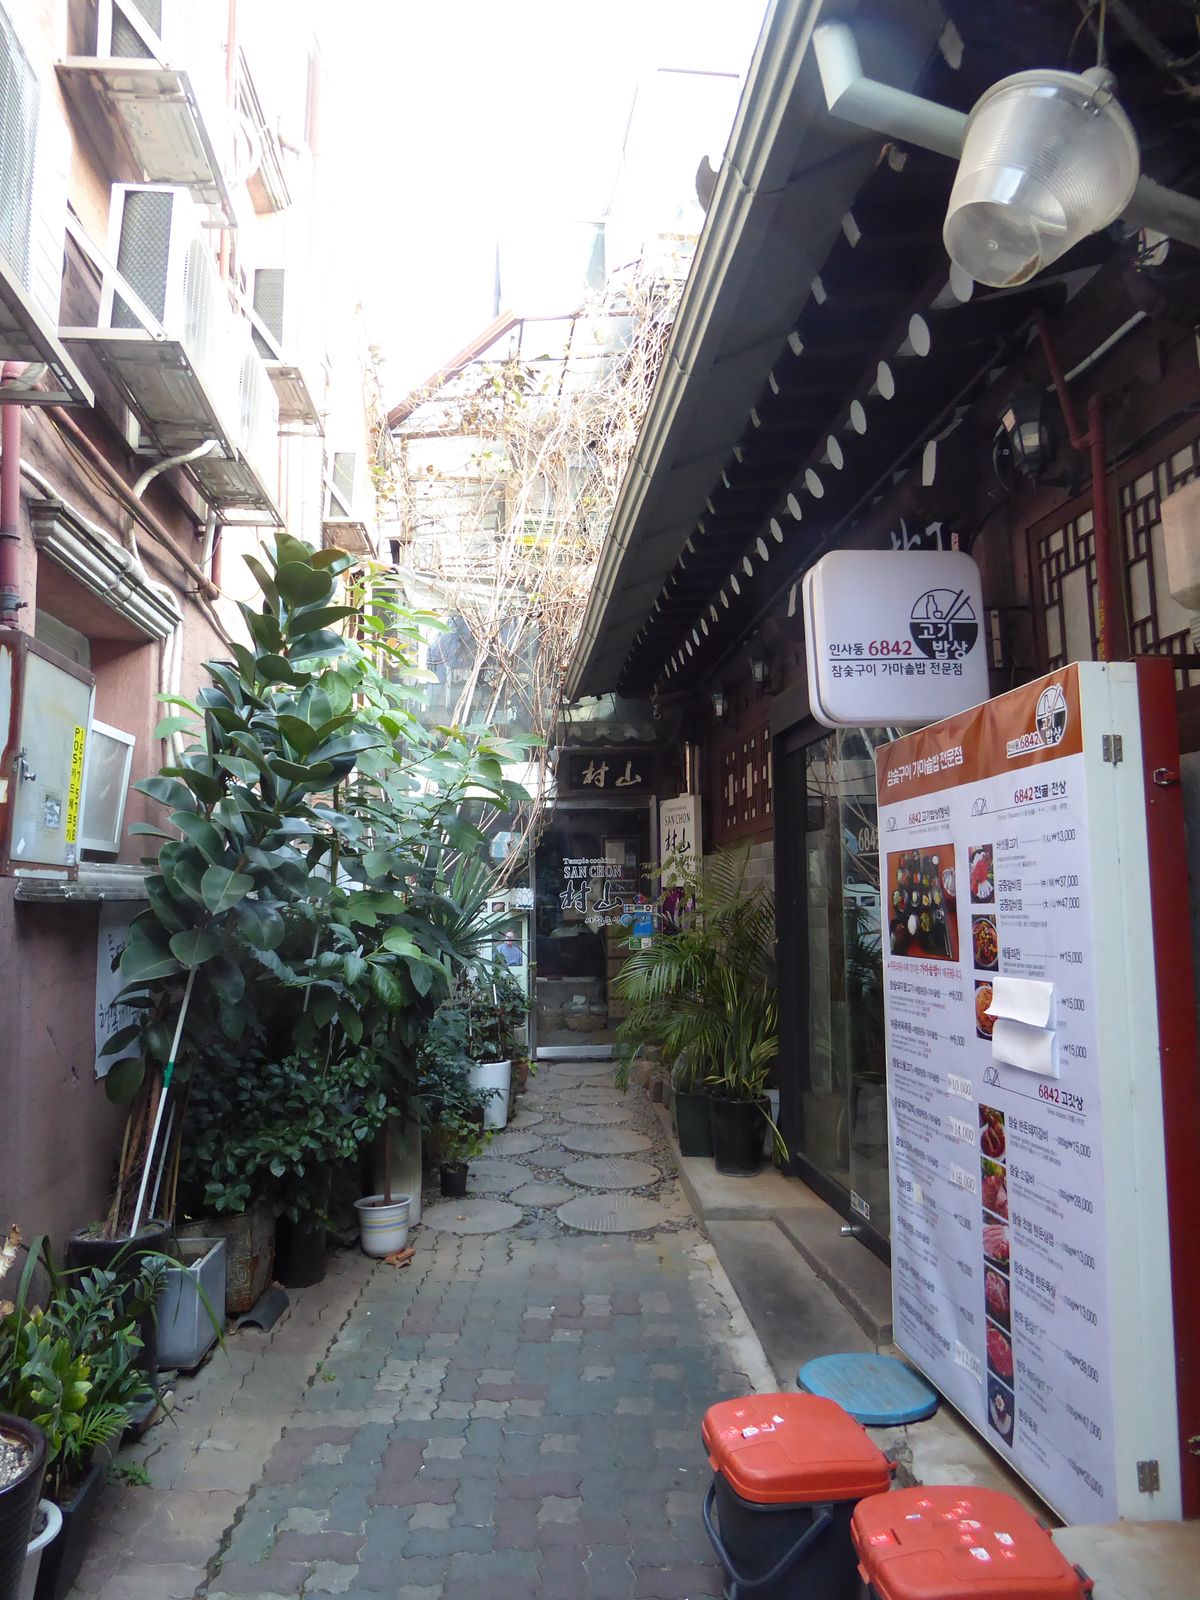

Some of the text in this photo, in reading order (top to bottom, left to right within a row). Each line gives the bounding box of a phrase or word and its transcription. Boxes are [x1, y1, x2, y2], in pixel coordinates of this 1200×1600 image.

[918, 623, 953, 641] 고기
[829, 640, 969, 659] 인사동 6842 밥상
[831, 662, 877, 678] 참숯구이
[929, 661, 963, 676] 전문점
[1040, 713, 1055, 731] 고기
[1020, 733, 1038, 750] 6842
[1045, 728, 1062, 745] 밥상
[939, 745, 964, 770] 전문점
[664, 812, 691, 826] SAN CHON
[562, 857, 589, 866] Temple
[563, 864, 622, 879] SAN CHON
[1038, 1084, 1083, 1110] 6842 고깃상
